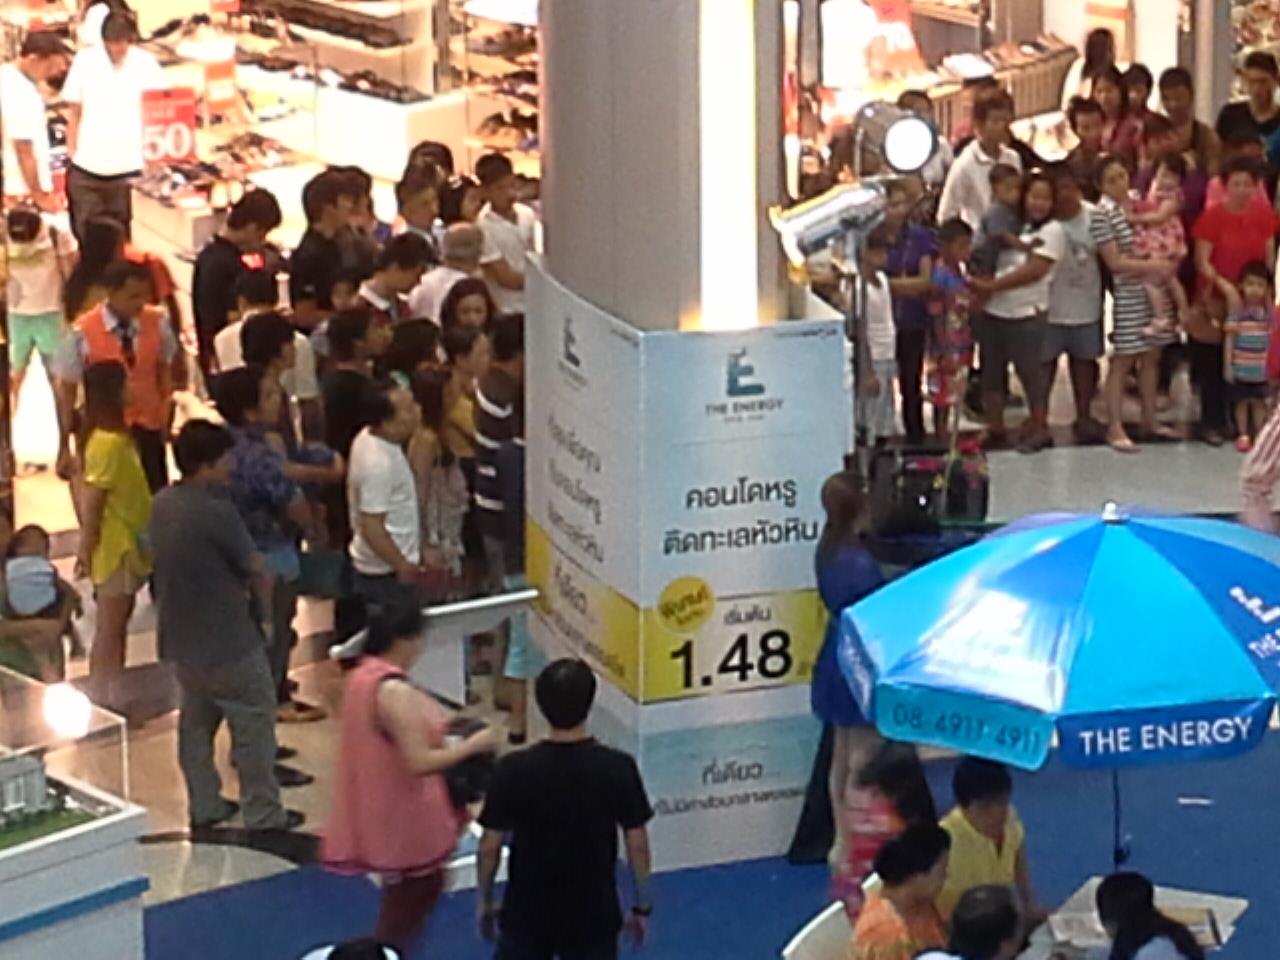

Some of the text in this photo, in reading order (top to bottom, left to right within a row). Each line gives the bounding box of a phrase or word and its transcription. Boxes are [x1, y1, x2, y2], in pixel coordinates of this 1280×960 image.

[686, 477, 797, 508] คอนโดหรู
[670, 629, 793, 689] 1.48
[1080, 714, 1253, 756] THE ENERGY
